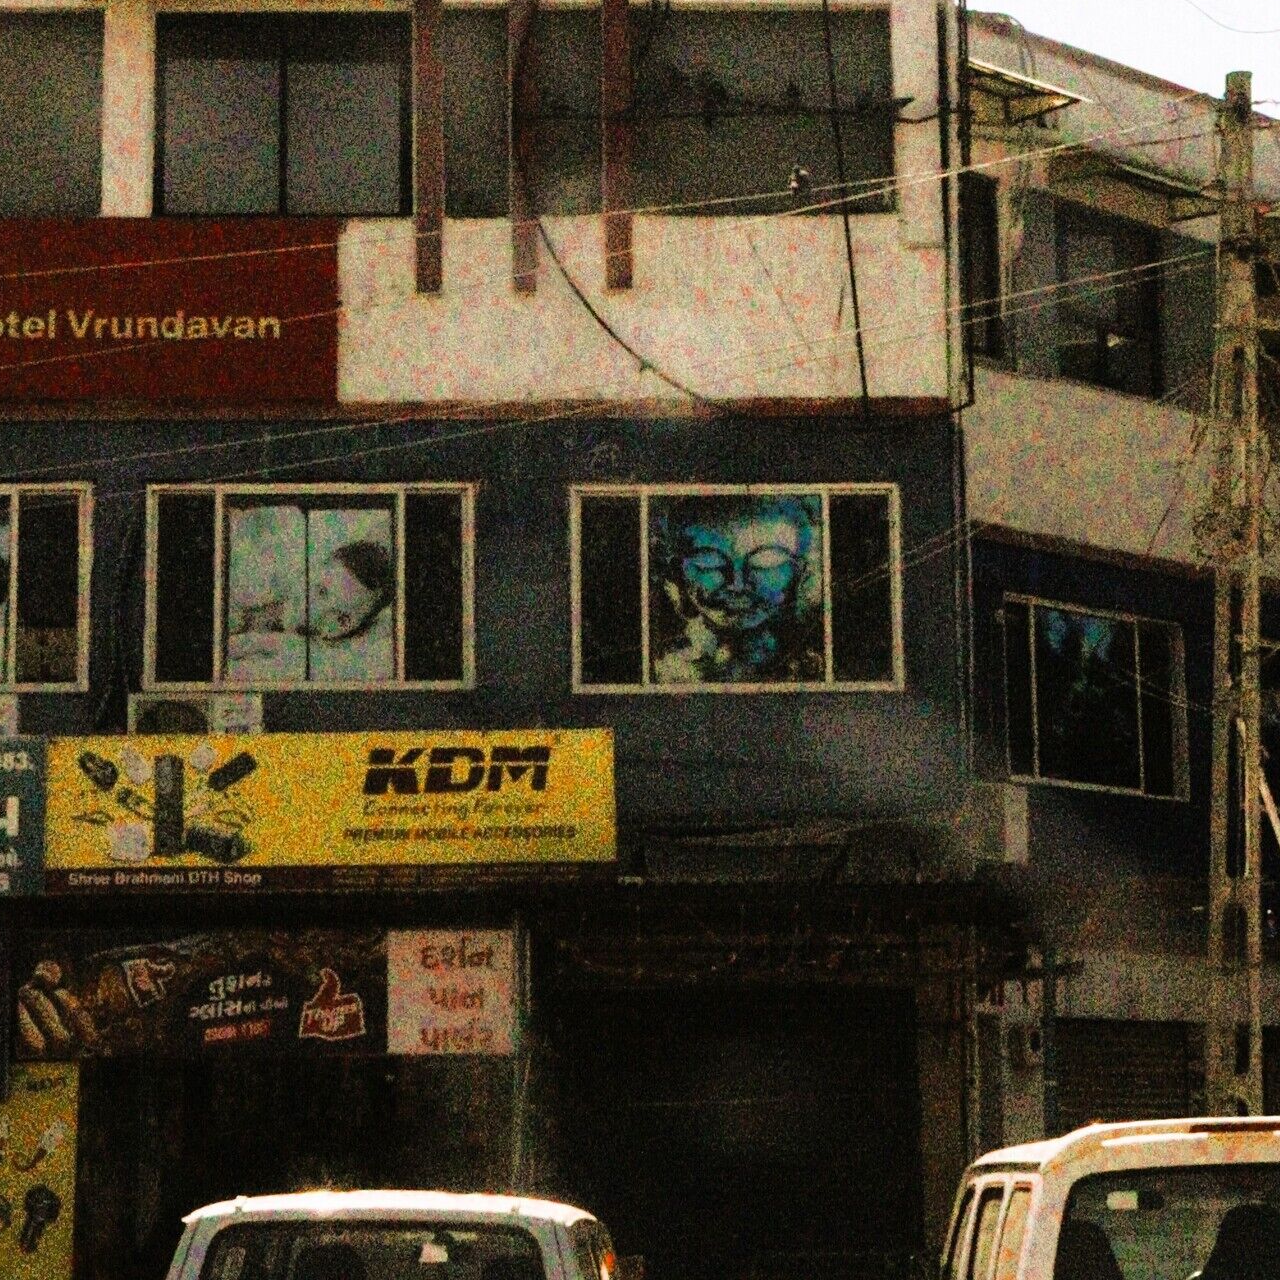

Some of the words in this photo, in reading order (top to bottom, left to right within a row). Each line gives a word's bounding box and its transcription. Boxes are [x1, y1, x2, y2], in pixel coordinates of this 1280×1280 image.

[70, 309, 281, 340] Vrundavan
[363, 746, 551, 795] KDM
[363, 799, 469, 820] Connecting
[473, 798, 543, 816] Forever
[344, 827, 410, 841] PREMIUM
[415, 826, 468, 840] MOBILE
[473, 825, 577, 840] ACCESSORIES
[68, 872, 110, 886] Shree
[188, 871, 220, 885] DTH
[223, 871, 261, 888] Shop
